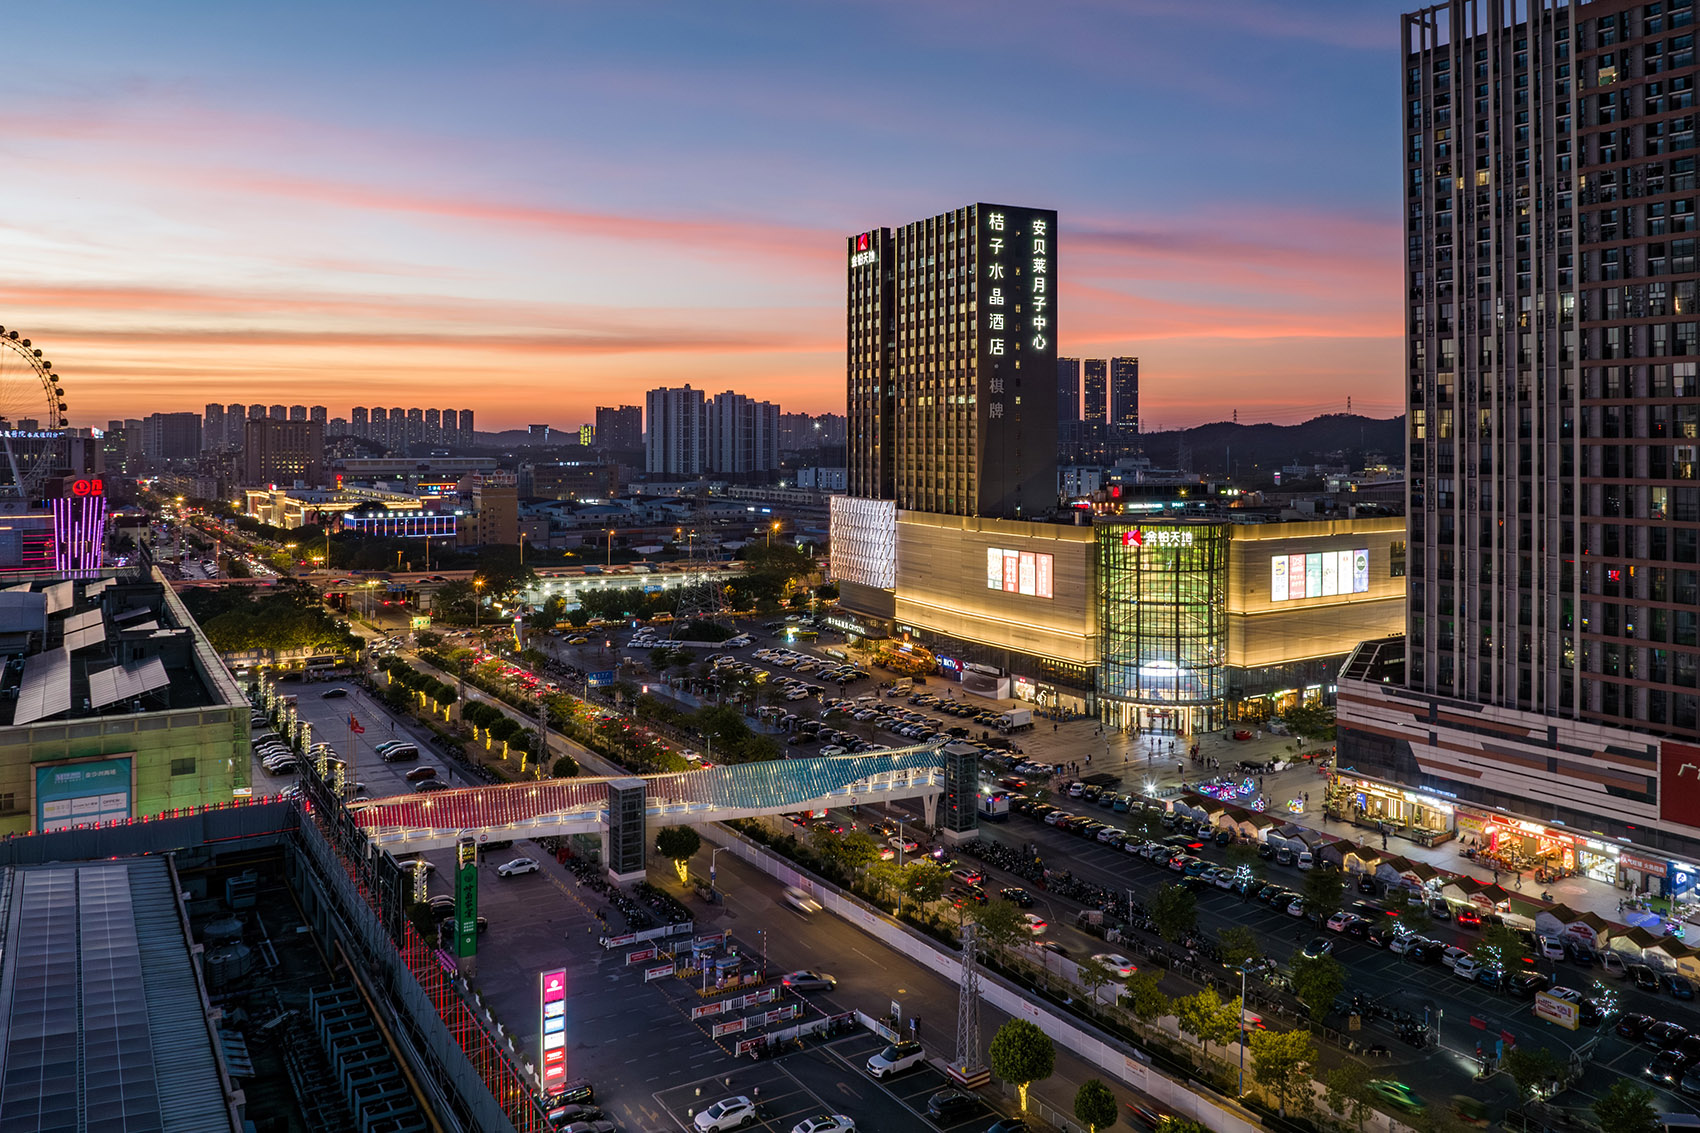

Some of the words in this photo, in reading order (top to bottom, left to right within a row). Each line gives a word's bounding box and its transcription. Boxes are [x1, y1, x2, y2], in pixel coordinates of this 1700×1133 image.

[989, 213, 1004, 355] 桔子水晶酒店
[1033, 219, 1046, 350] 安贝莱月子中心
